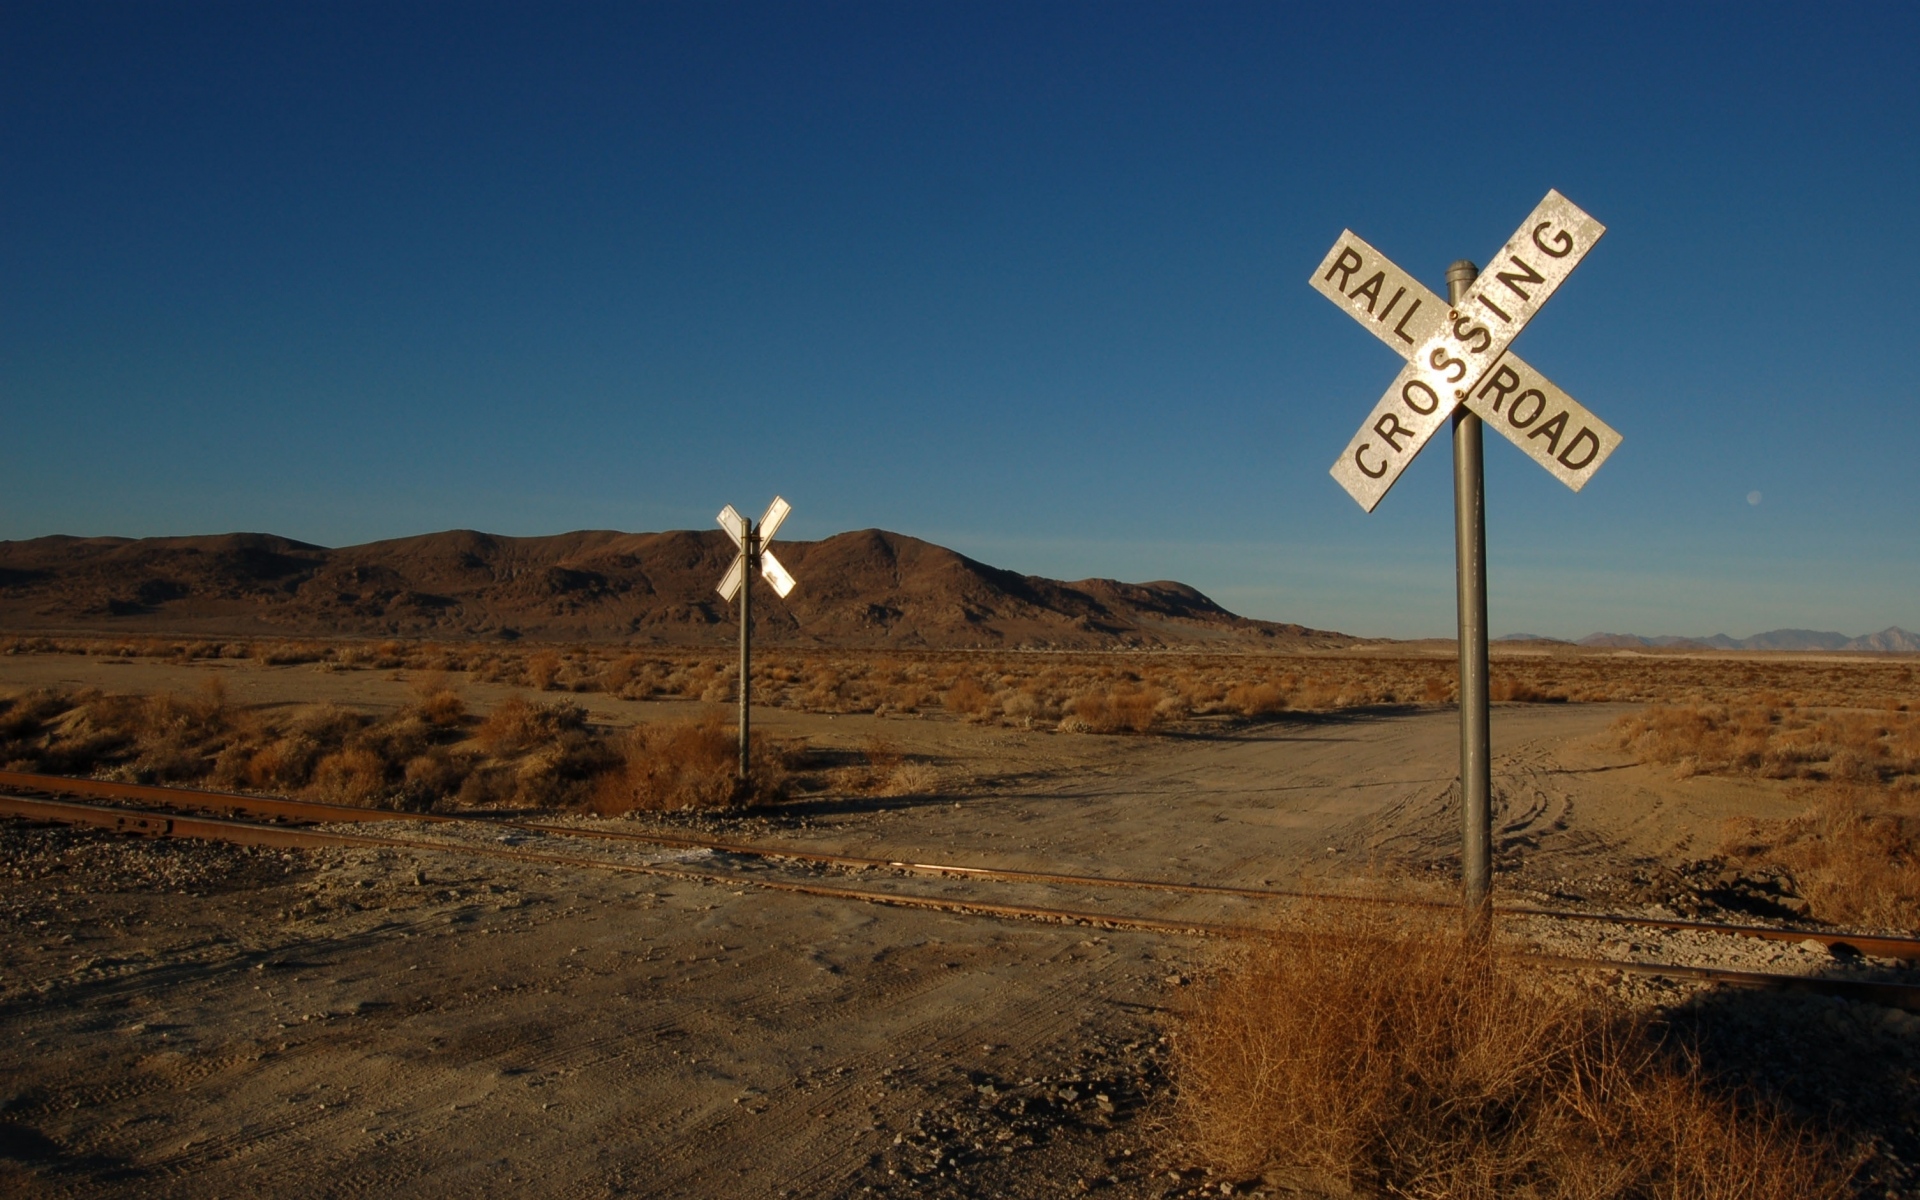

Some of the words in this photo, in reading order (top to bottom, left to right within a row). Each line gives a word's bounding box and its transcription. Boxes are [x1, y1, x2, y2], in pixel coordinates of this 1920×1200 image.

[1324, 246, 1422, 345] RAIL
[1477, 363, 1600, 471] ROAD
[1354, 221, 1573, 479] CROSSING
